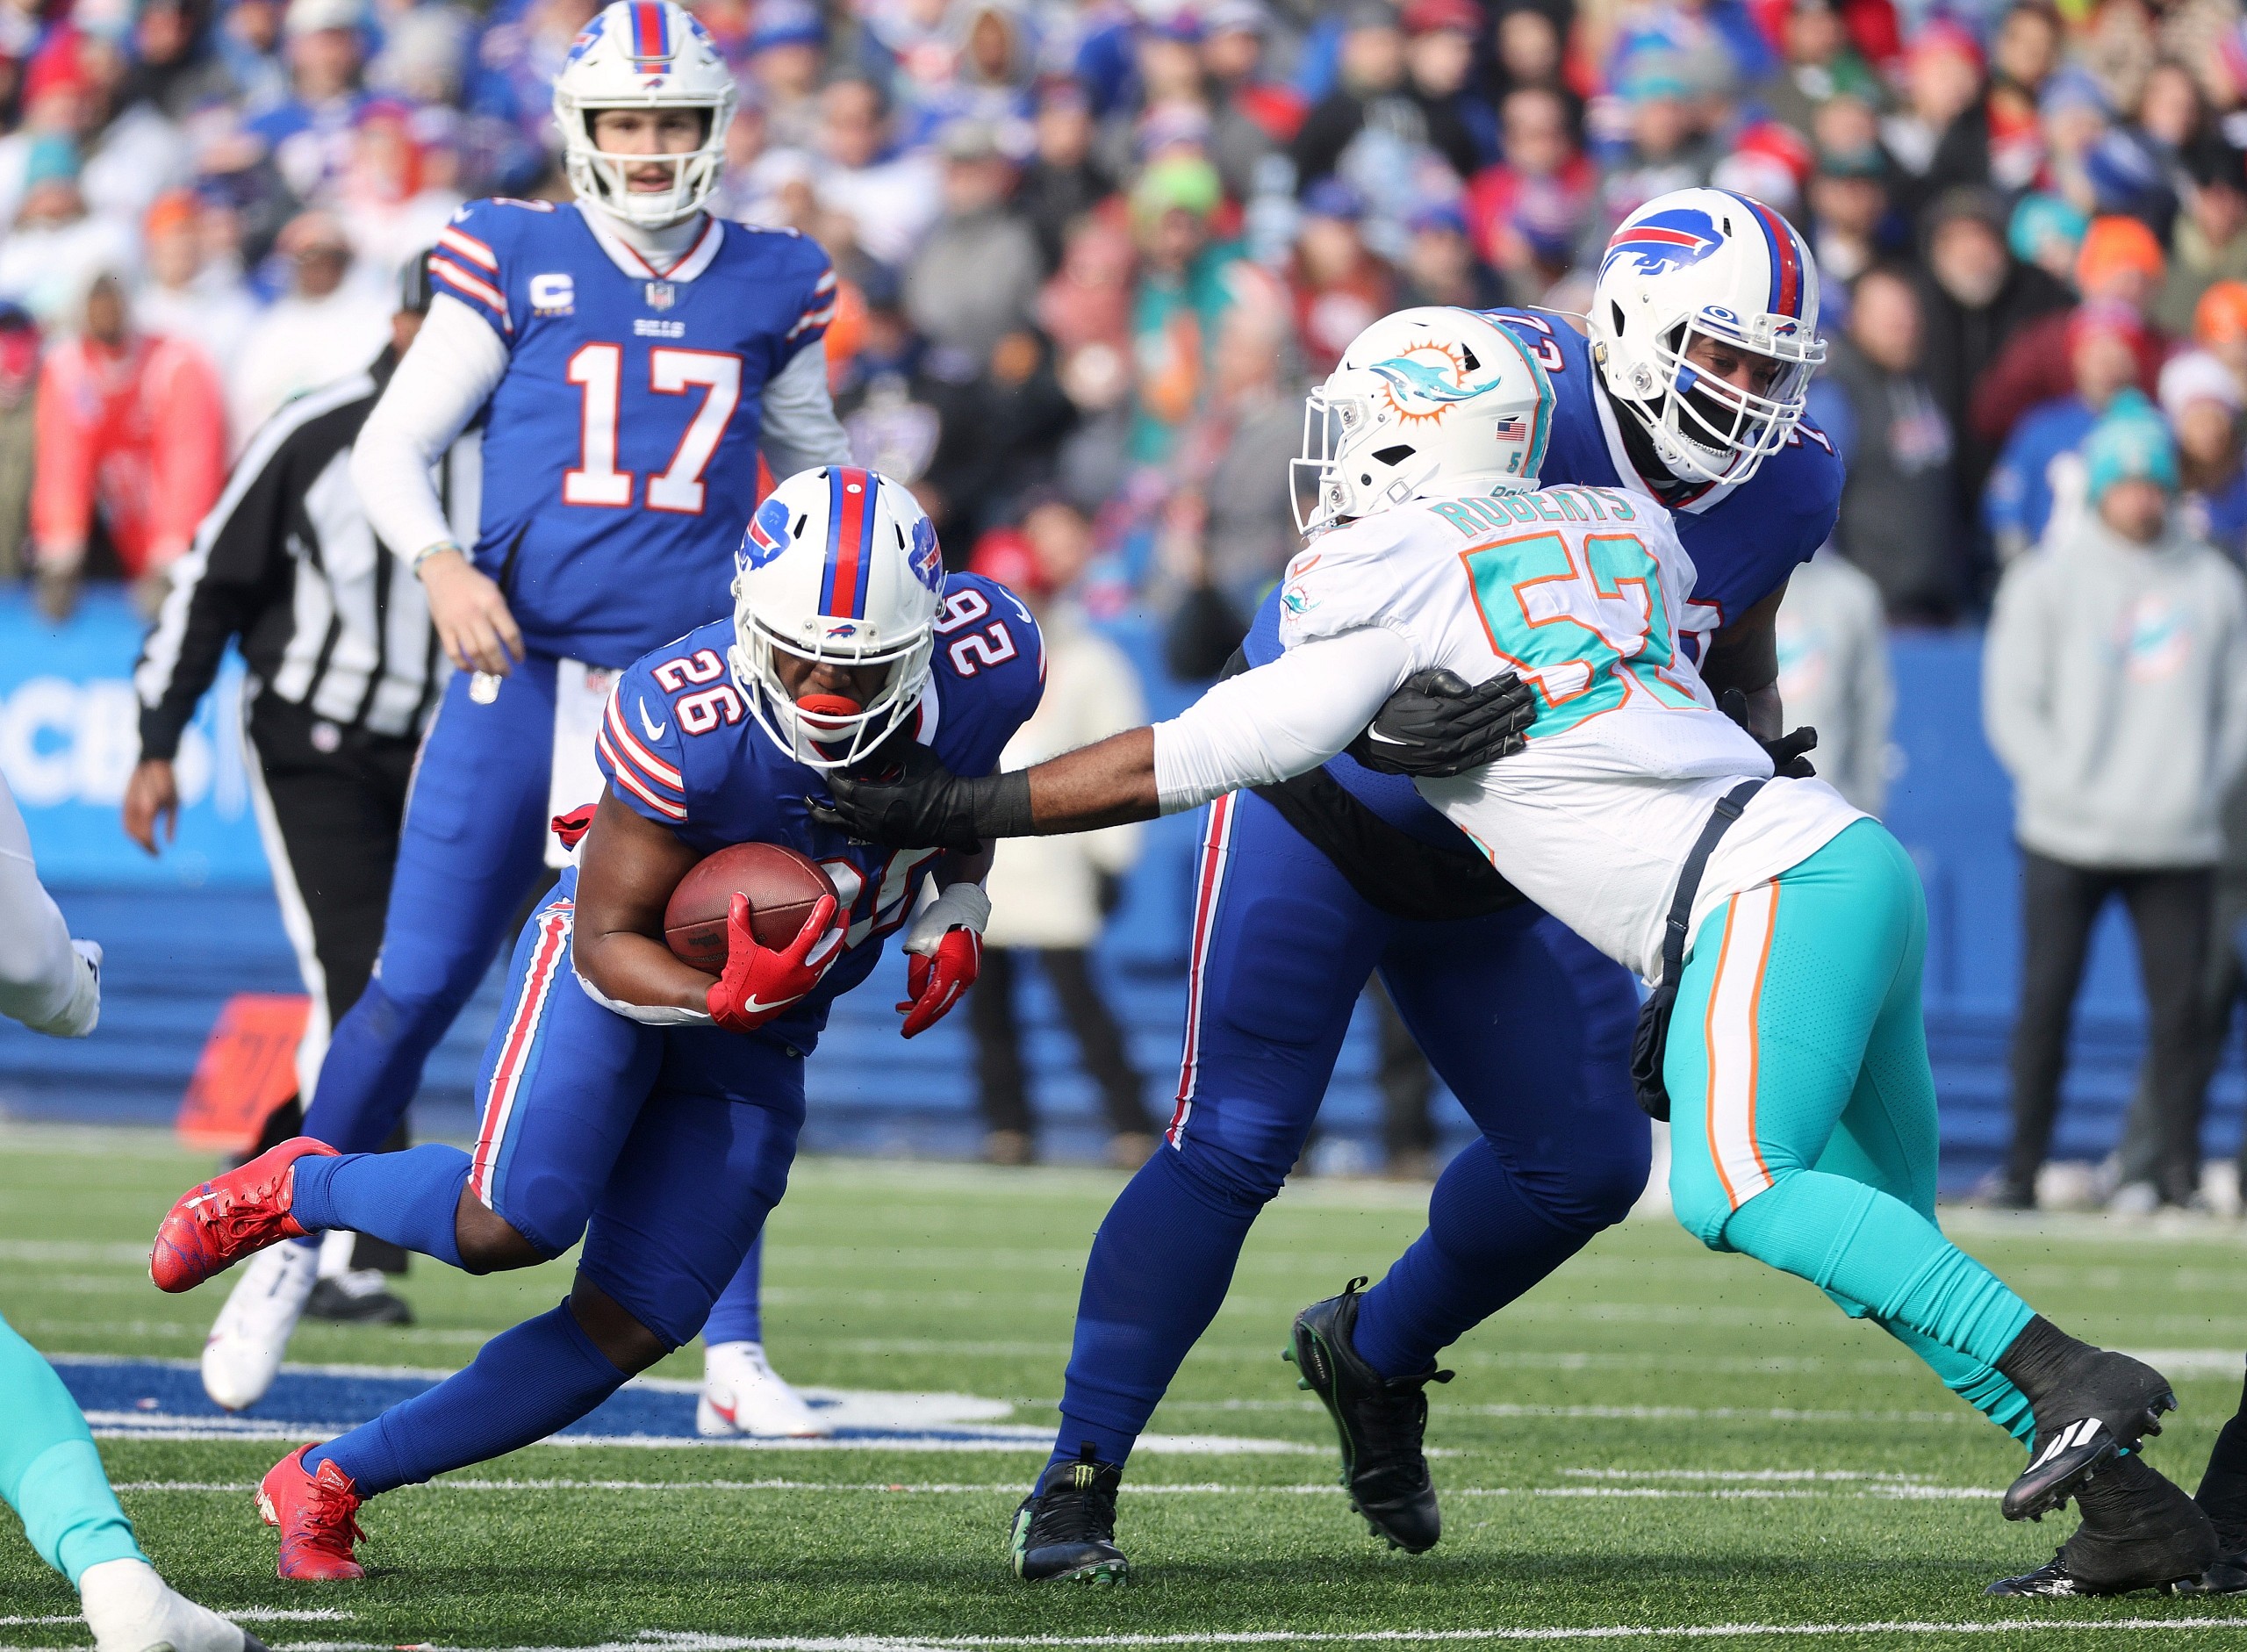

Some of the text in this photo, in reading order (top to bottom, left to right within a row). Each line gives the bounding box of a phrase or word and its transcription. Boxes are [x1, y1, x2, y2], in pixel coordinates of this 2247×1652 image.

[529, 273, 575, 309] C
[562, 340, 744, 516] 17
[1427, 485, 1636, 539] ROBERTS
[931, 587, 1018, 679] 26
[650, 648, 744, 736] 26
